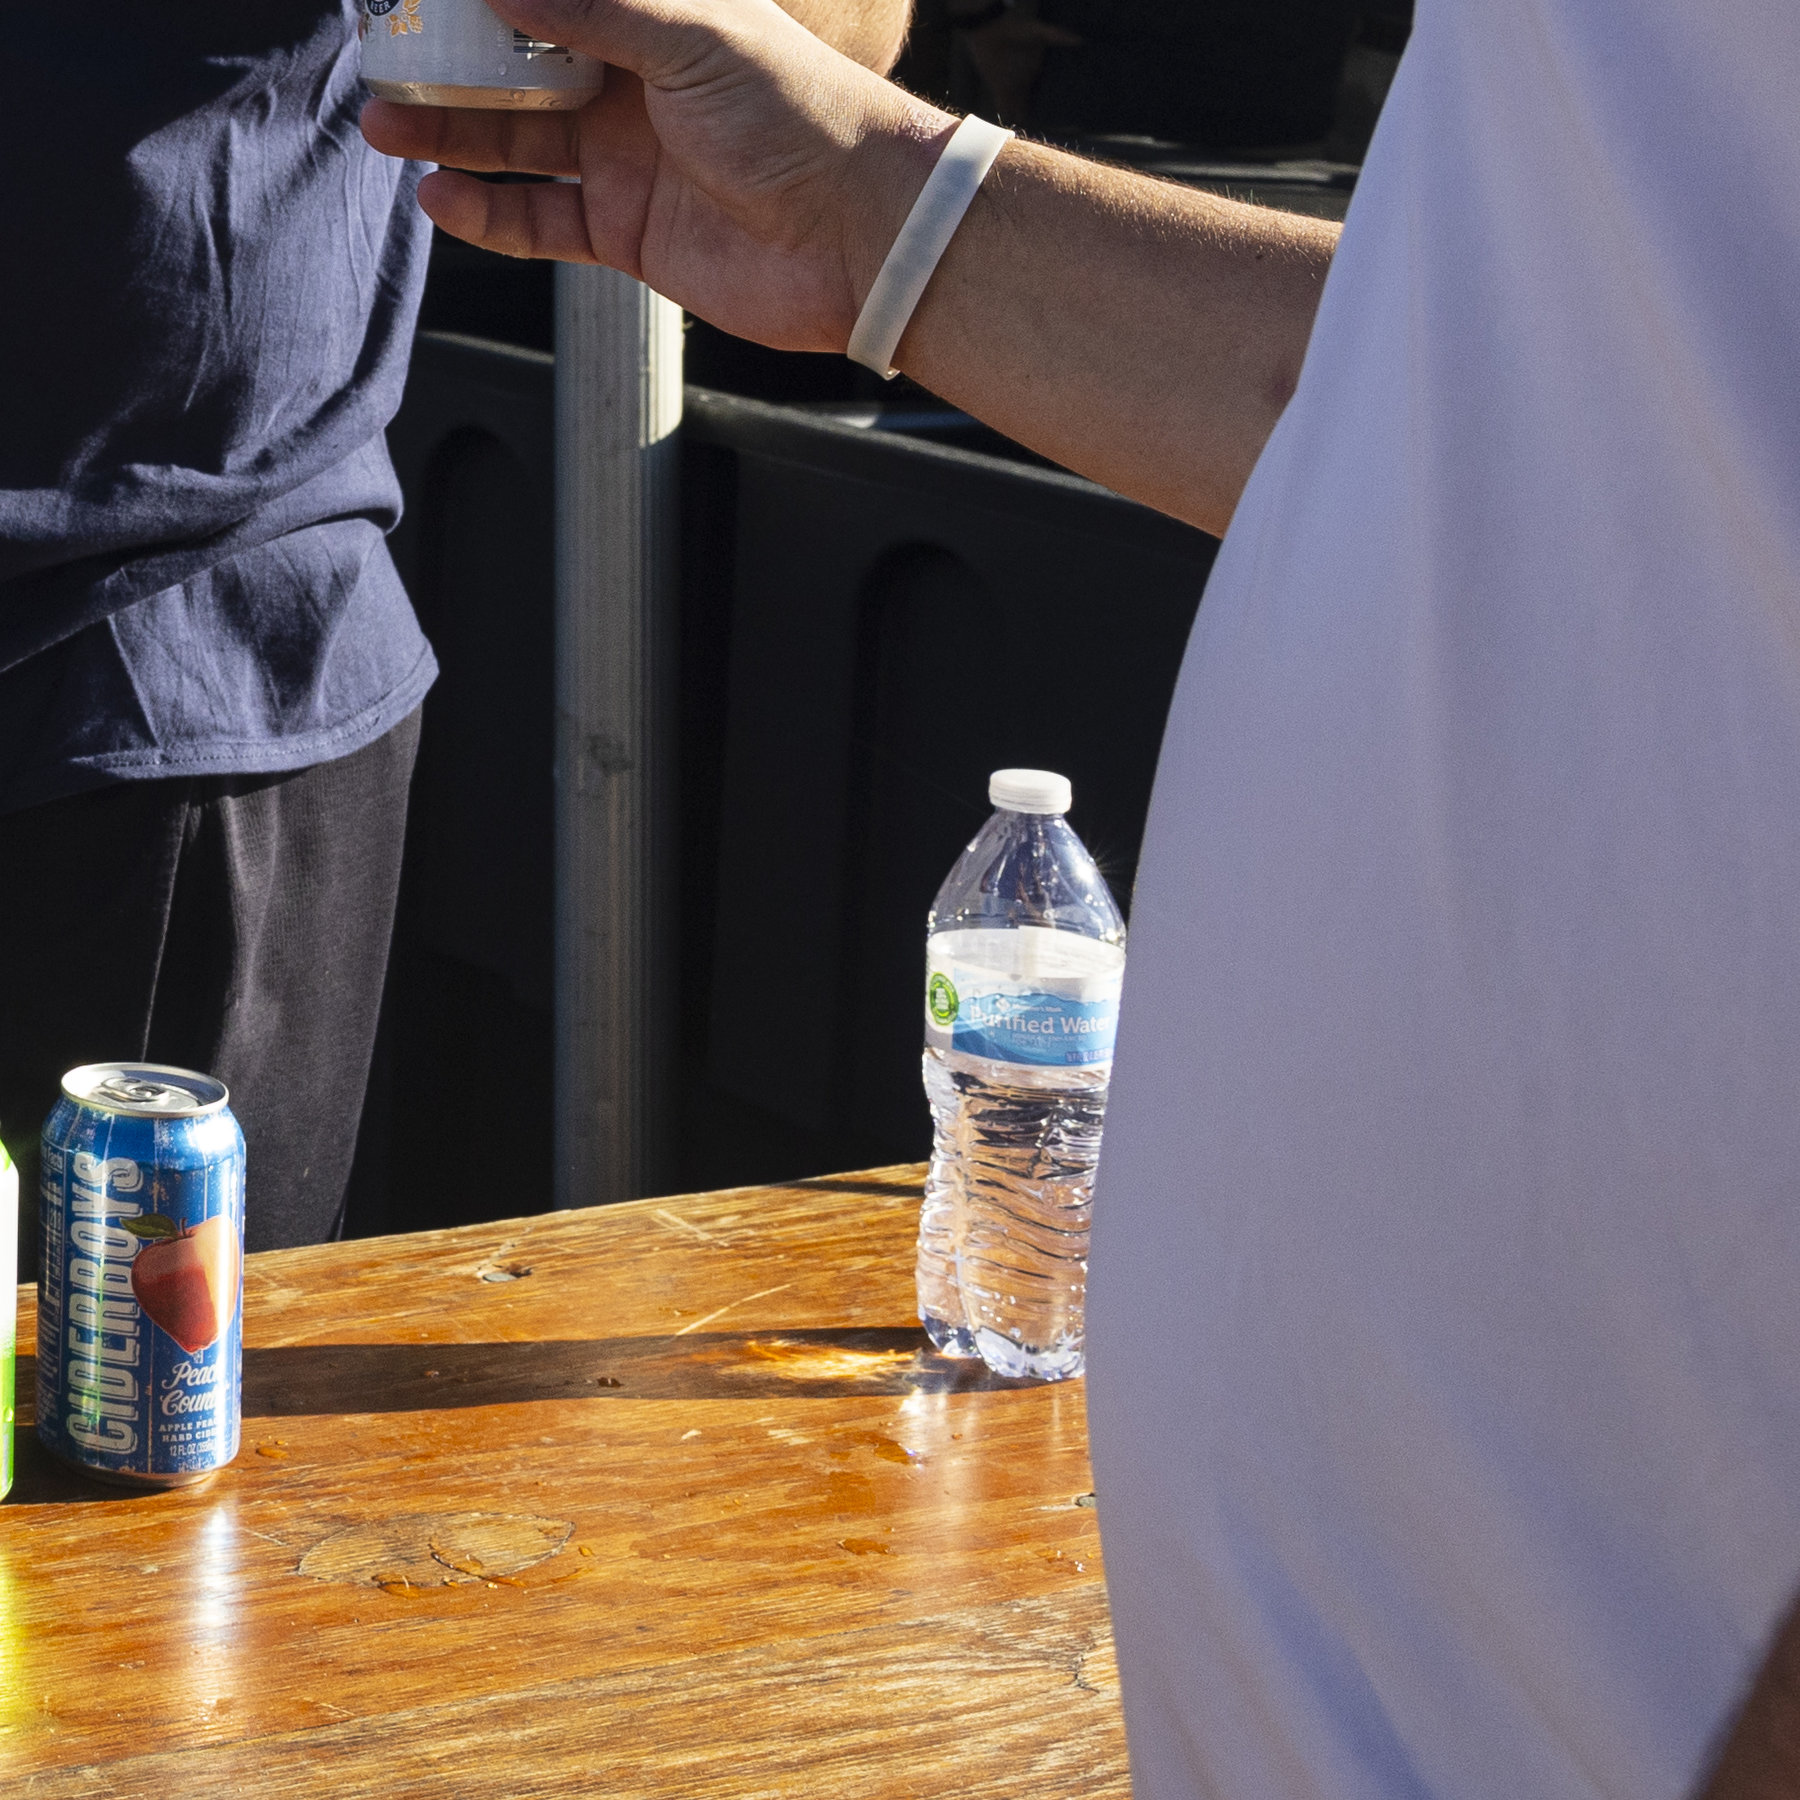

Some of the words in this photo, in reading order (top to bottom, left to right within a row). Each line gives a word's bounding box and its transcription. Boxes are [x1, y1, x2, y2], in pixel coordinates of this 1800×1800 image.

[969, 1004, 1055, 1034] Purified
[1060, 1014, 1112, 1034] Water
[66, 1151, 145, 1456] CIDERBOYS
[158, 1422, 194, 1433] APPLE
[162, 1432, 193, 1442] HARD
[169, 1445, 177, 1457] 12
